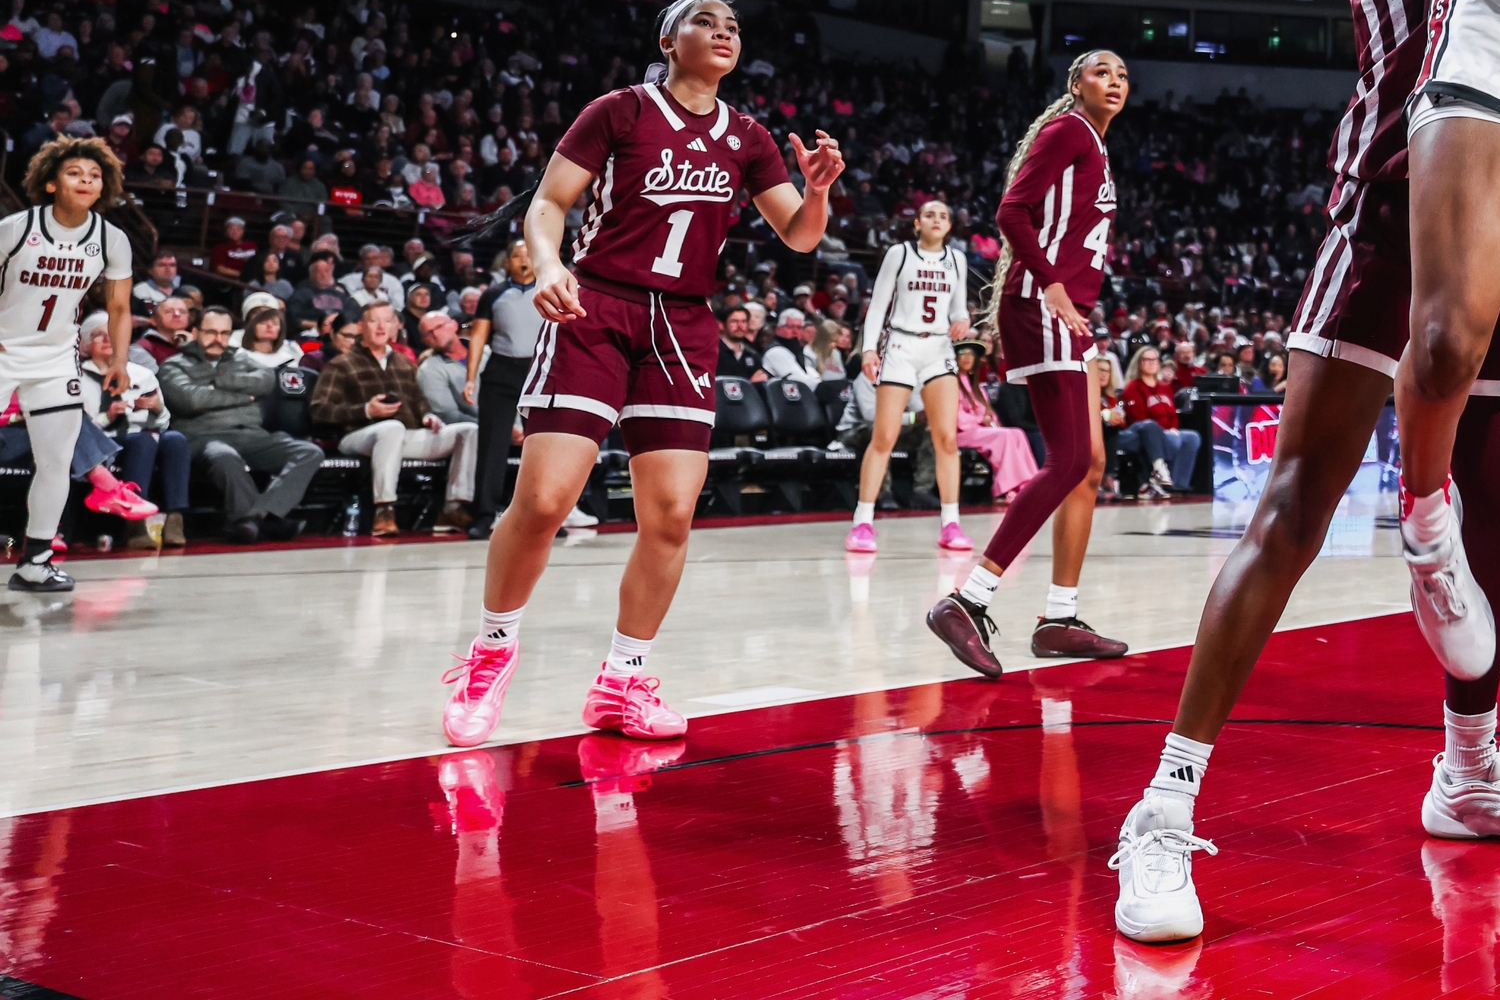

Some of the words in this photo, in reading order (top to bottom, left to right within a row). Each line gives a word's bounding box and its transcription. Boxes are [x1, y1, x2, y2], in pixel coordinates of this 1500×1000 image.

[640, 148, 733, 206] State
[651, 209, 694, 278] 1
[1083, 216, 1111, 271] 4
[37, 256, 84, 272] SOUTH
[917, 269, 945, 280] SOUTH
[908, 281, 951, 293] CAROLINA
[37, 294, 58, 332] 1
[922, 295, 937, 323] 5
